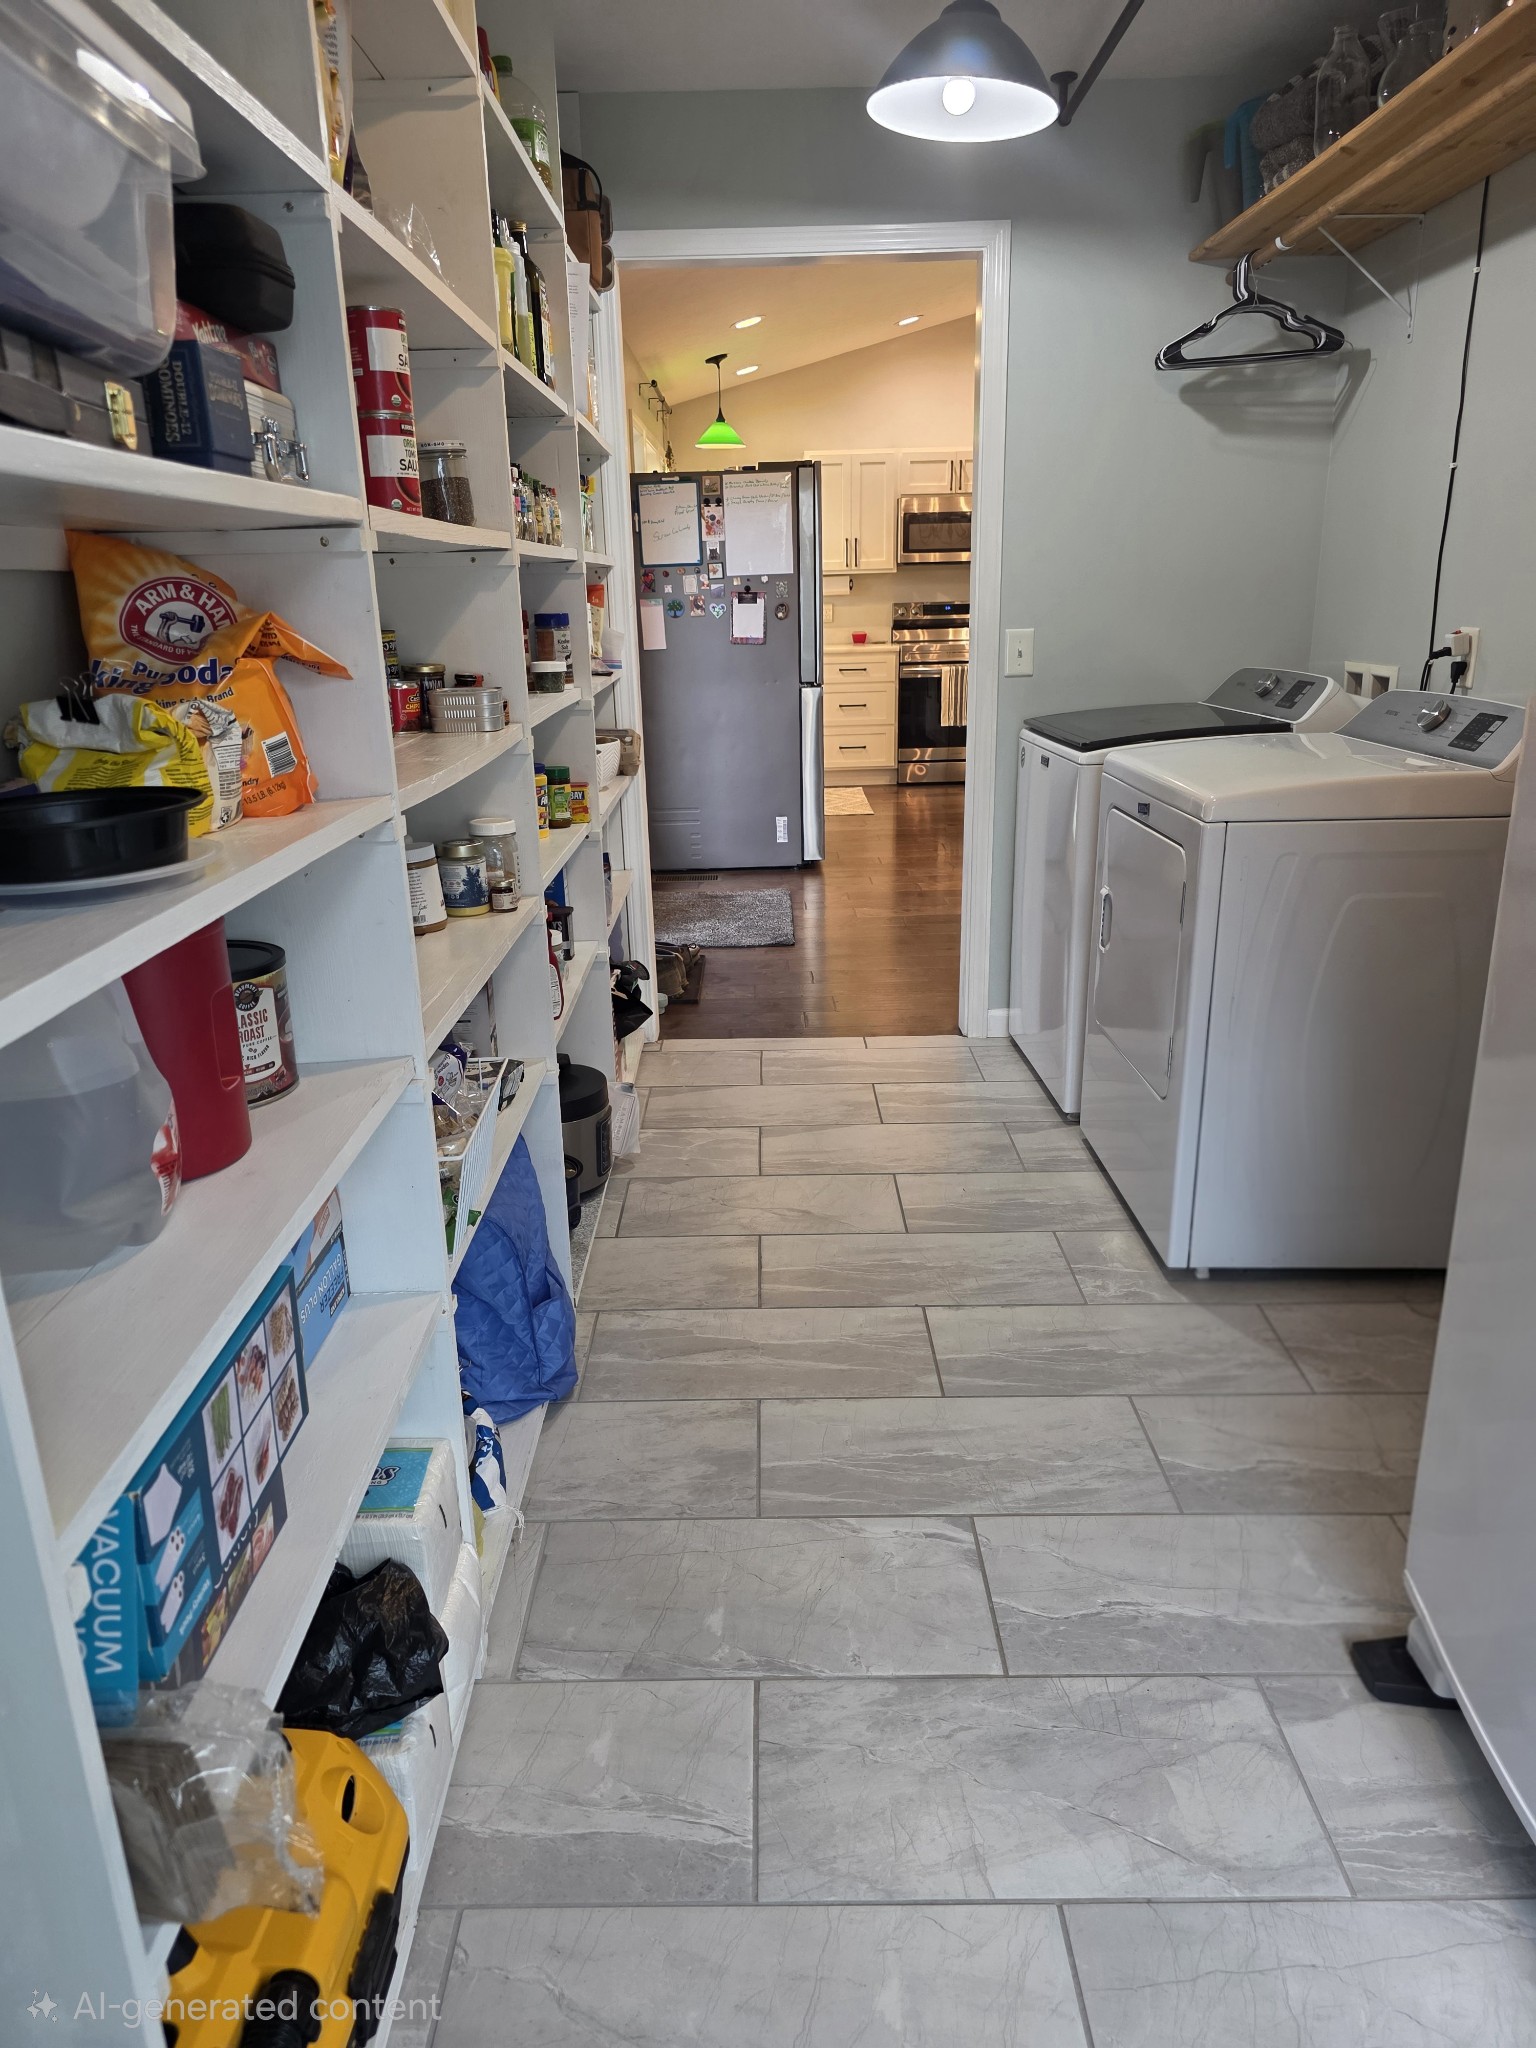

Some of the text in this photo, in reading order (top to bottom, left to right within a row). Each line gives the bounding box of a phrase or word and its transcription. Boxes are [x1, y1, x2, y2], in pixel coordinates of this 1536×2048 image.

[135, 583, 177, 616] ARM
[179, 584, 195, 602] &
[207, 687, 234, 704] Brand
[244, 794, 258, 805] 13.5
[570, 790, 583, 800] BAY
[318, 1253, 342, 1294] GALLON
[300, 1291, 318, 1324] PLUS
[320, 1270, 344, 1313] FREEZER
[91, 1508, 123, 1675] VACUUM
